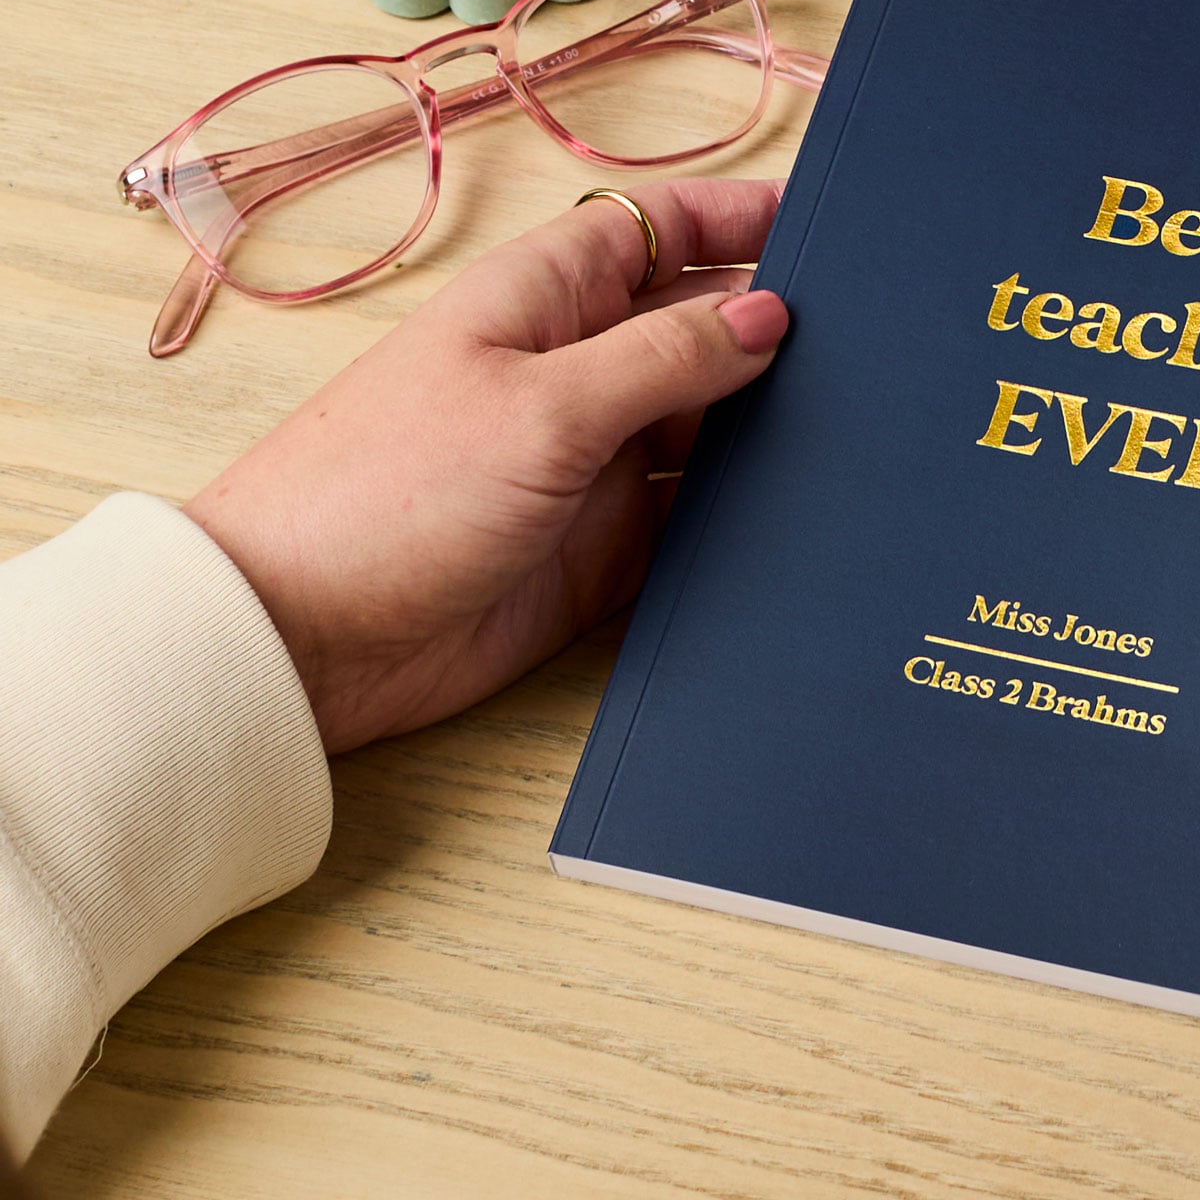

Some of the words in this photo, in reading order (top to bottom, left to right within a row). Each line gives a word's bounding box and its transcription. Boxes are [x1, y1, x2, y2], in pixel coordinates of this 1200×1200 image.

[549, 48, 579, 66] +1.00
[968, 595, 1051, 636] Miss
[1054, 614, 1153, 656] Jones
[904, 656, 996, 698] Class
[1000, 679, 1023, 704] 2
[1026, 681, 1166, 734] Brahms
